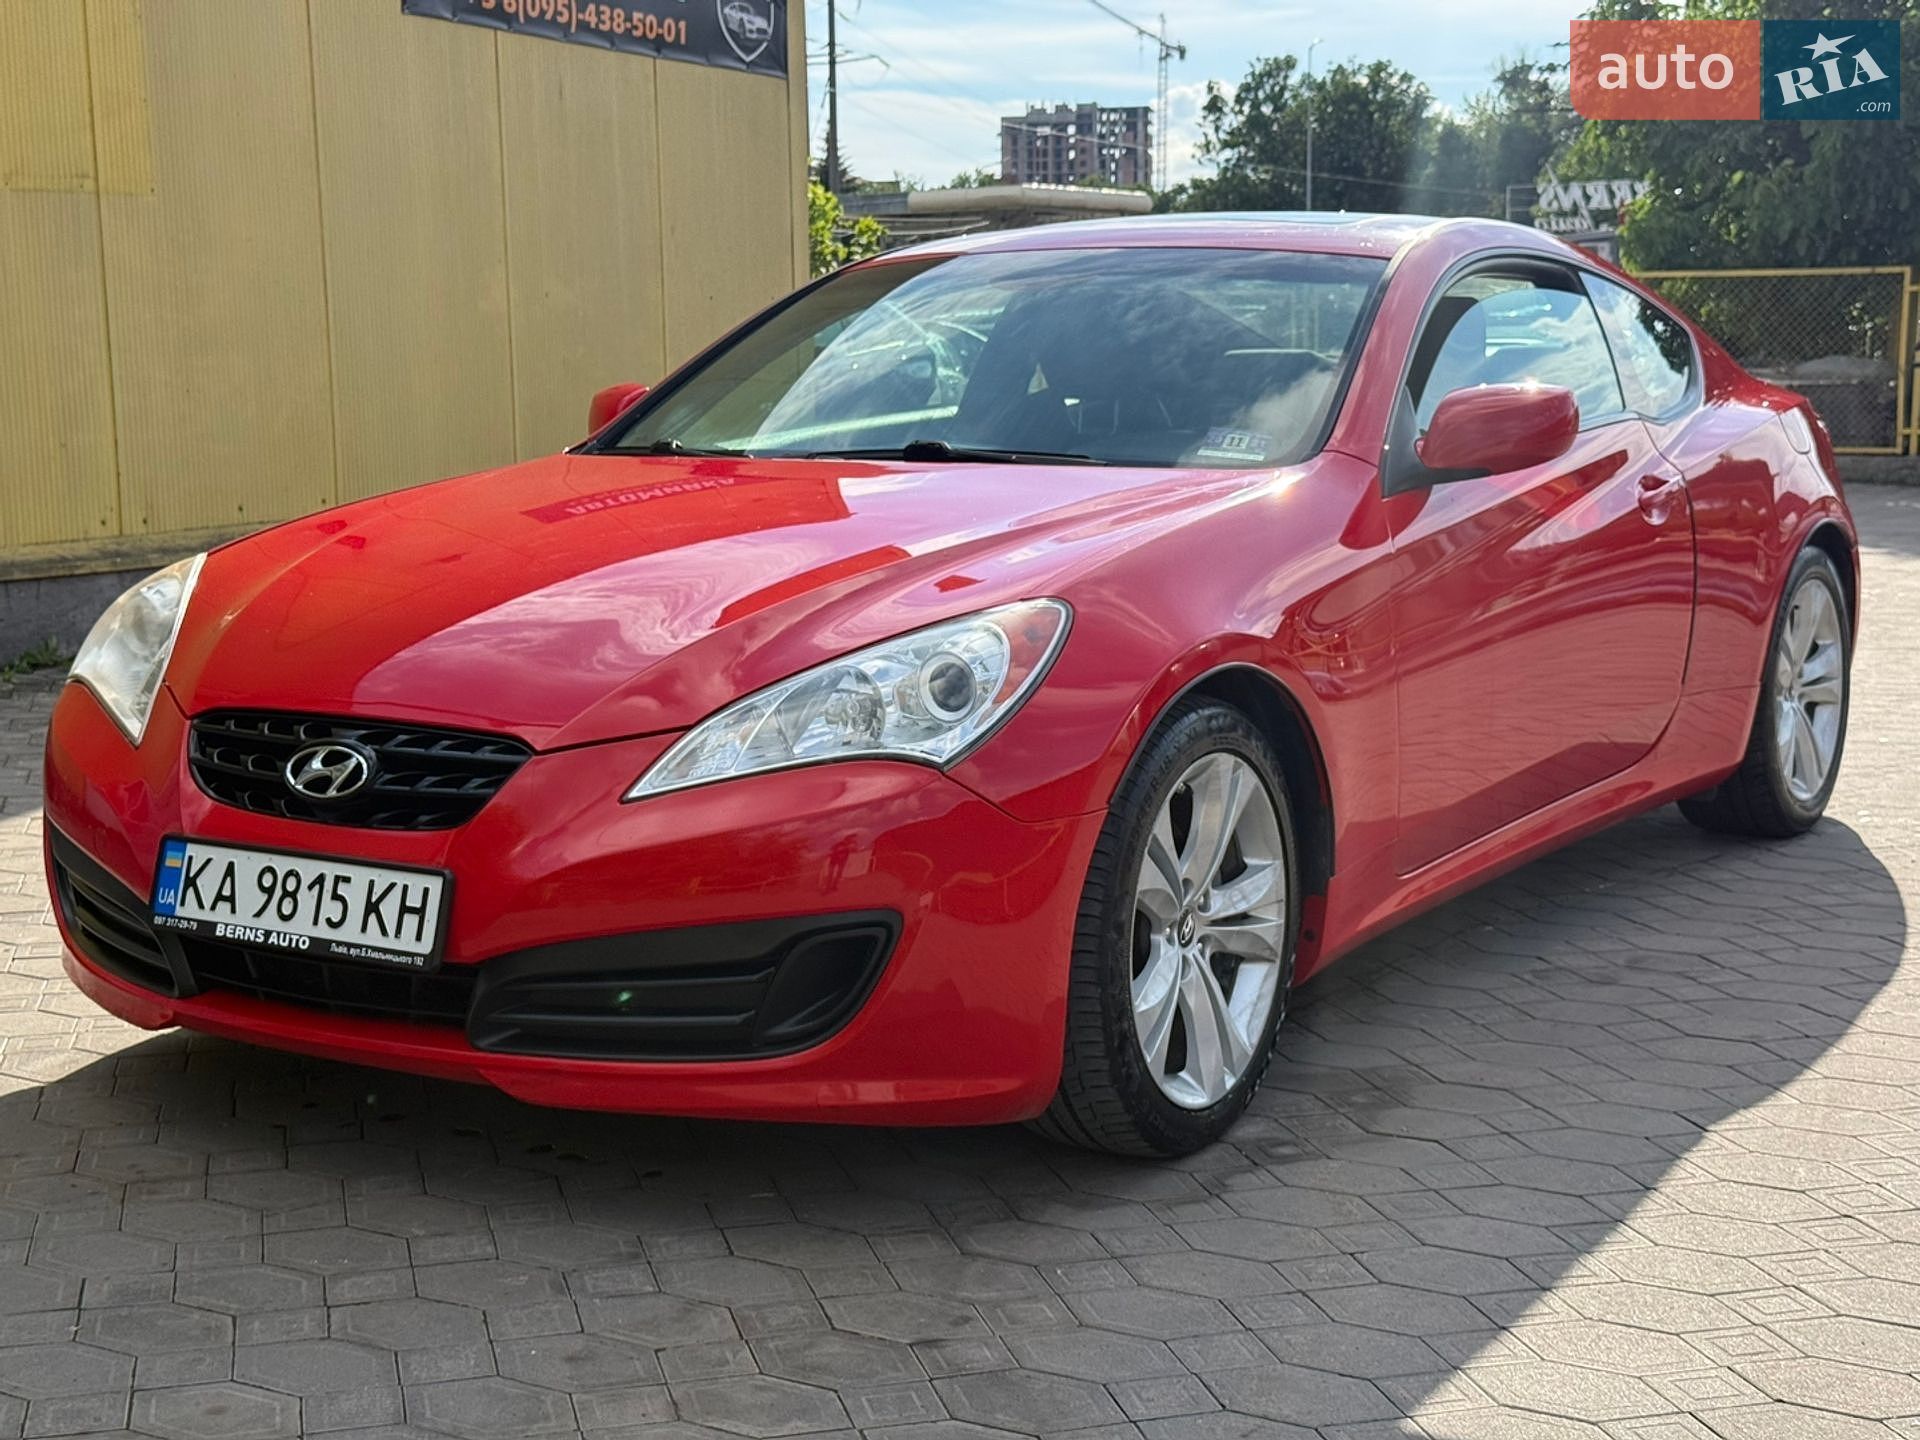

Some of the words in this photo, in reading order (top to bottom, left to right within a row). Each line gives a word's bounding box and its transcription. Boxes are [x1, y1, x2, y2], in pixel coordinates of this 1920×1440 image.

[158, 887, 176, 906] UA
[179, 854, 237, 915] KA
[252, 864, 353, 930] 9815
[360, 878, 431, 943] KH
[215, 923, 266, 944] BERNS
[267, 930, 310, 951] AUTO
